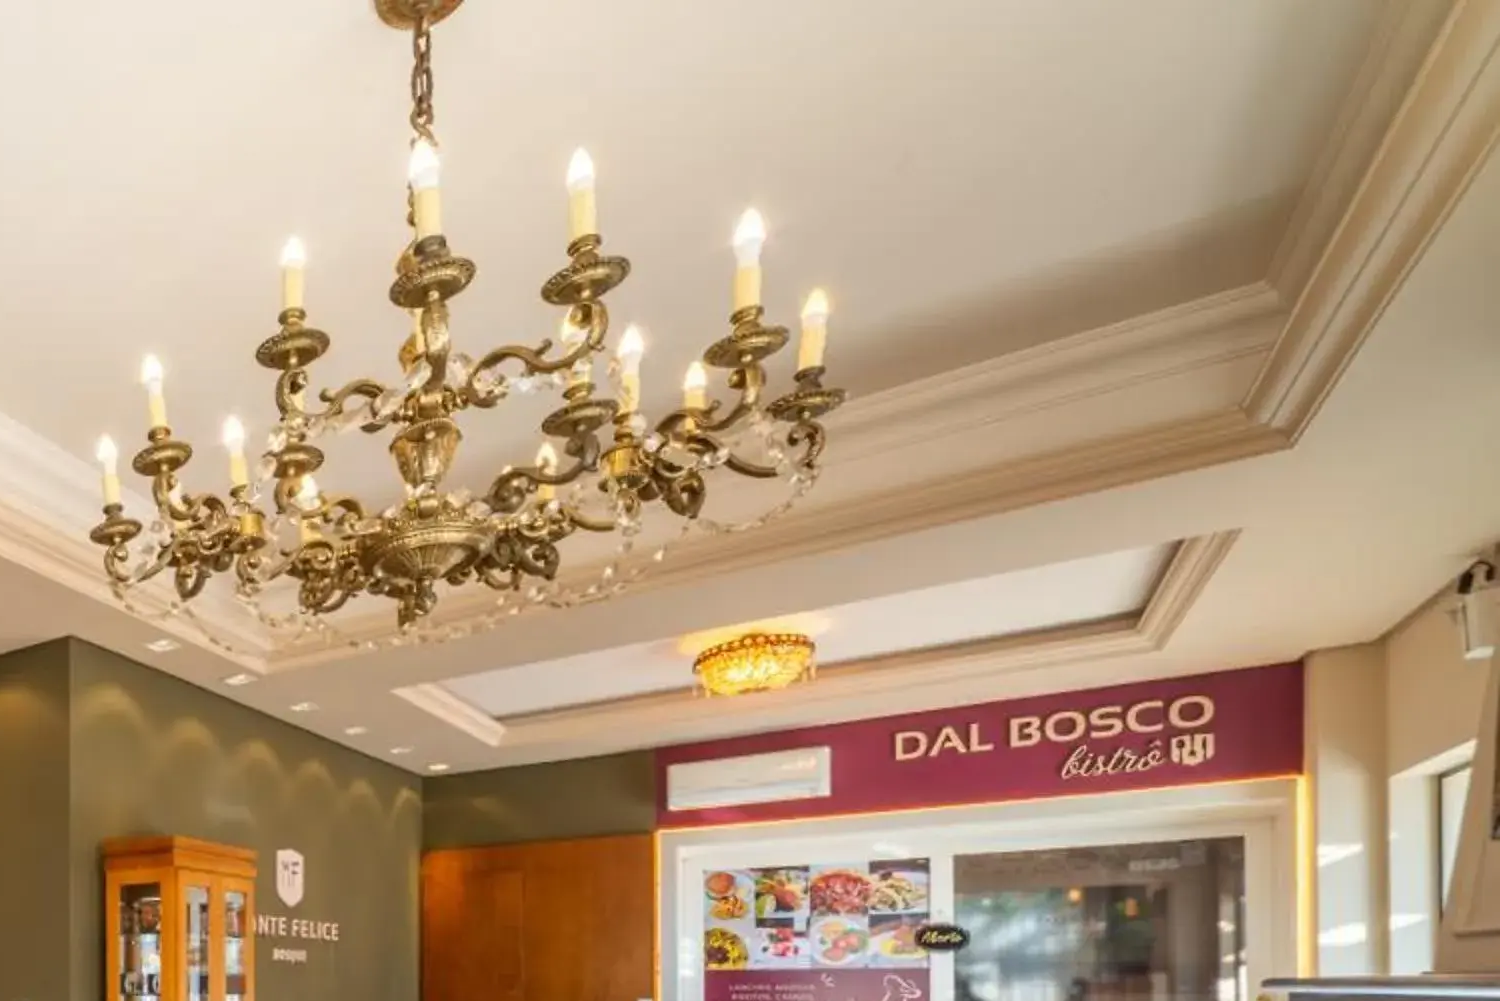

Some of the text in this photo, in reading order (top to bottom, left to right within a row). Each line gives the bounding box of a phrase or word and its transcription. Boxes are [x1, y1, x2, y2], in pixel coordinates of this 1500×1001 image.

[894, 694, 1216, 761] DAL BOSCO
[1060, 739, 1168, 780] bistrô
[291, 918, 340, 942] FELICE
